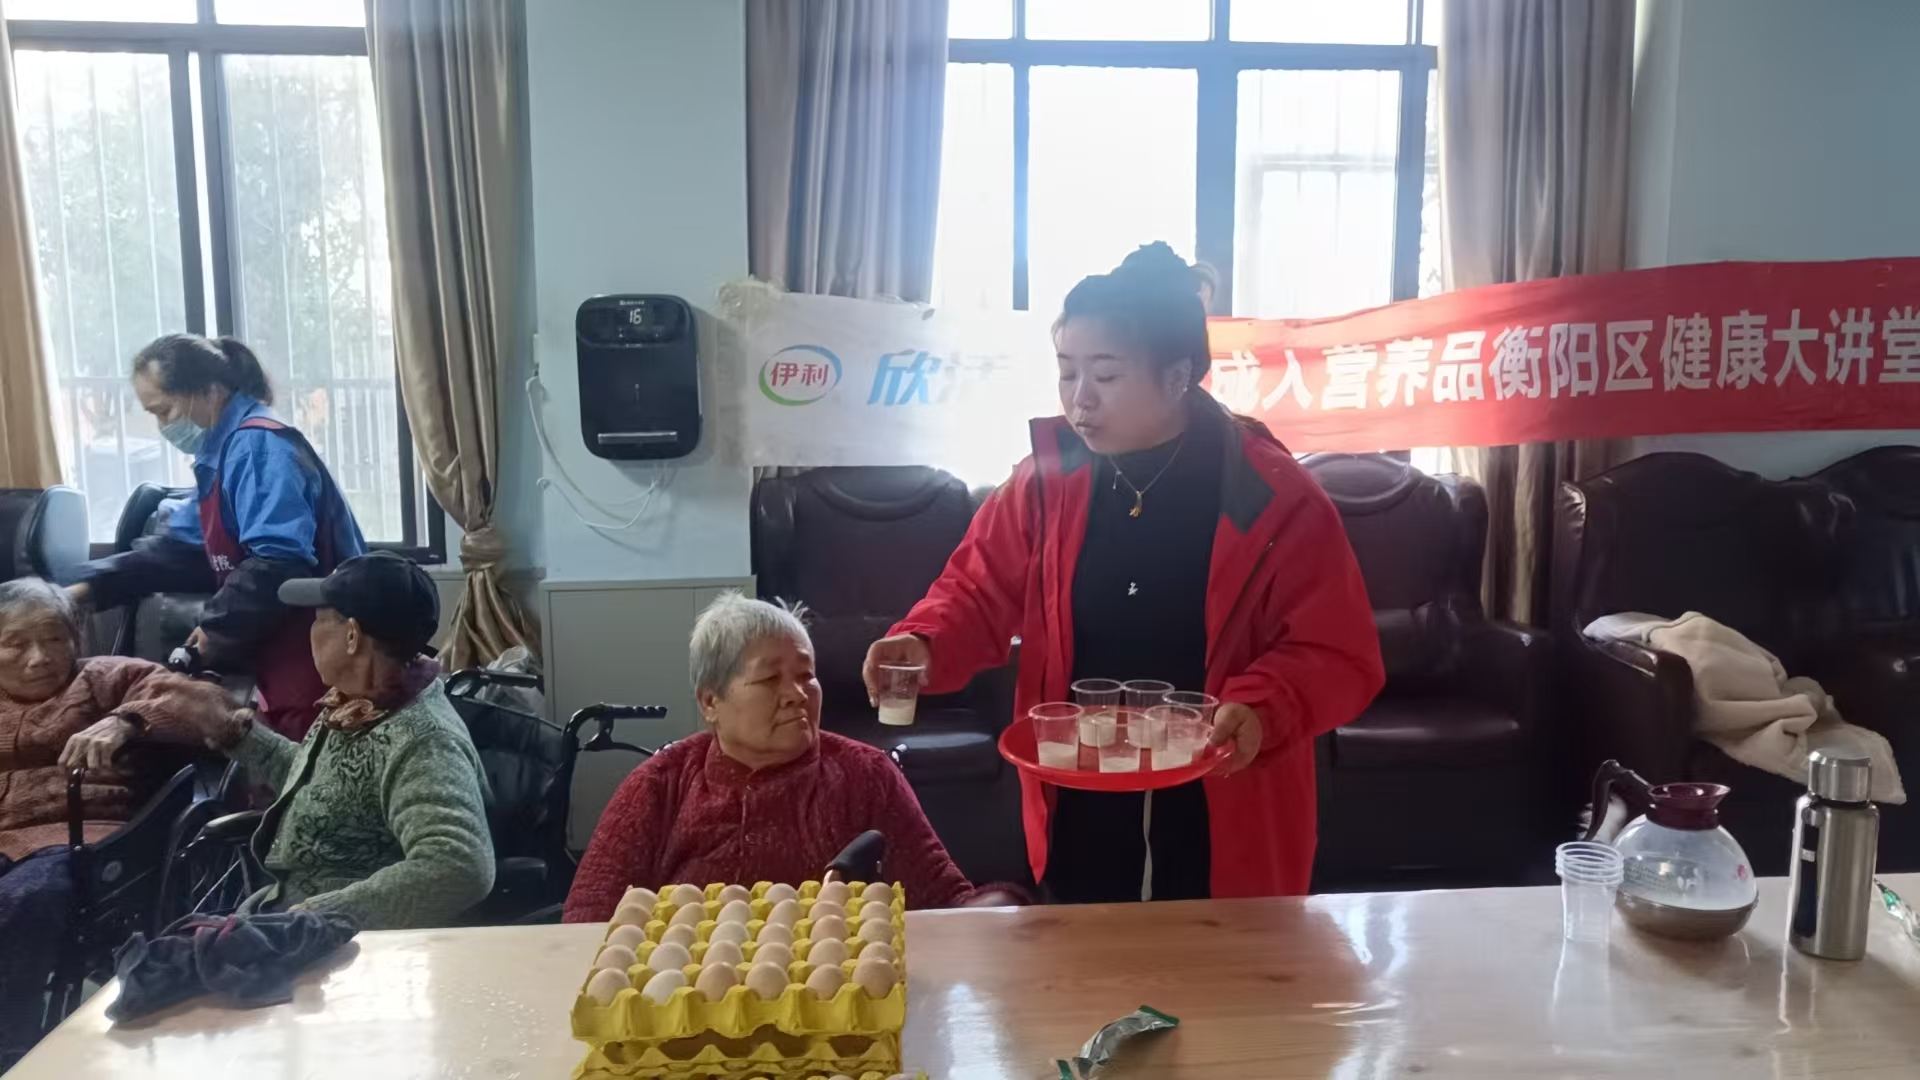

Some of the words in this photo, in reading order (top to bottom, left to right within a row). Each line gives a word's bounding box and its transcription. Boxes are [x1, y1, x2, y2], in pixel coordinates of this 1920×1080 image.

[629, 308, 642, 325] 16
[1209, 305, 1920, 413] 成人营养品衡阳区健康大讲堂
[769, 361, 829, 387] 伊利
